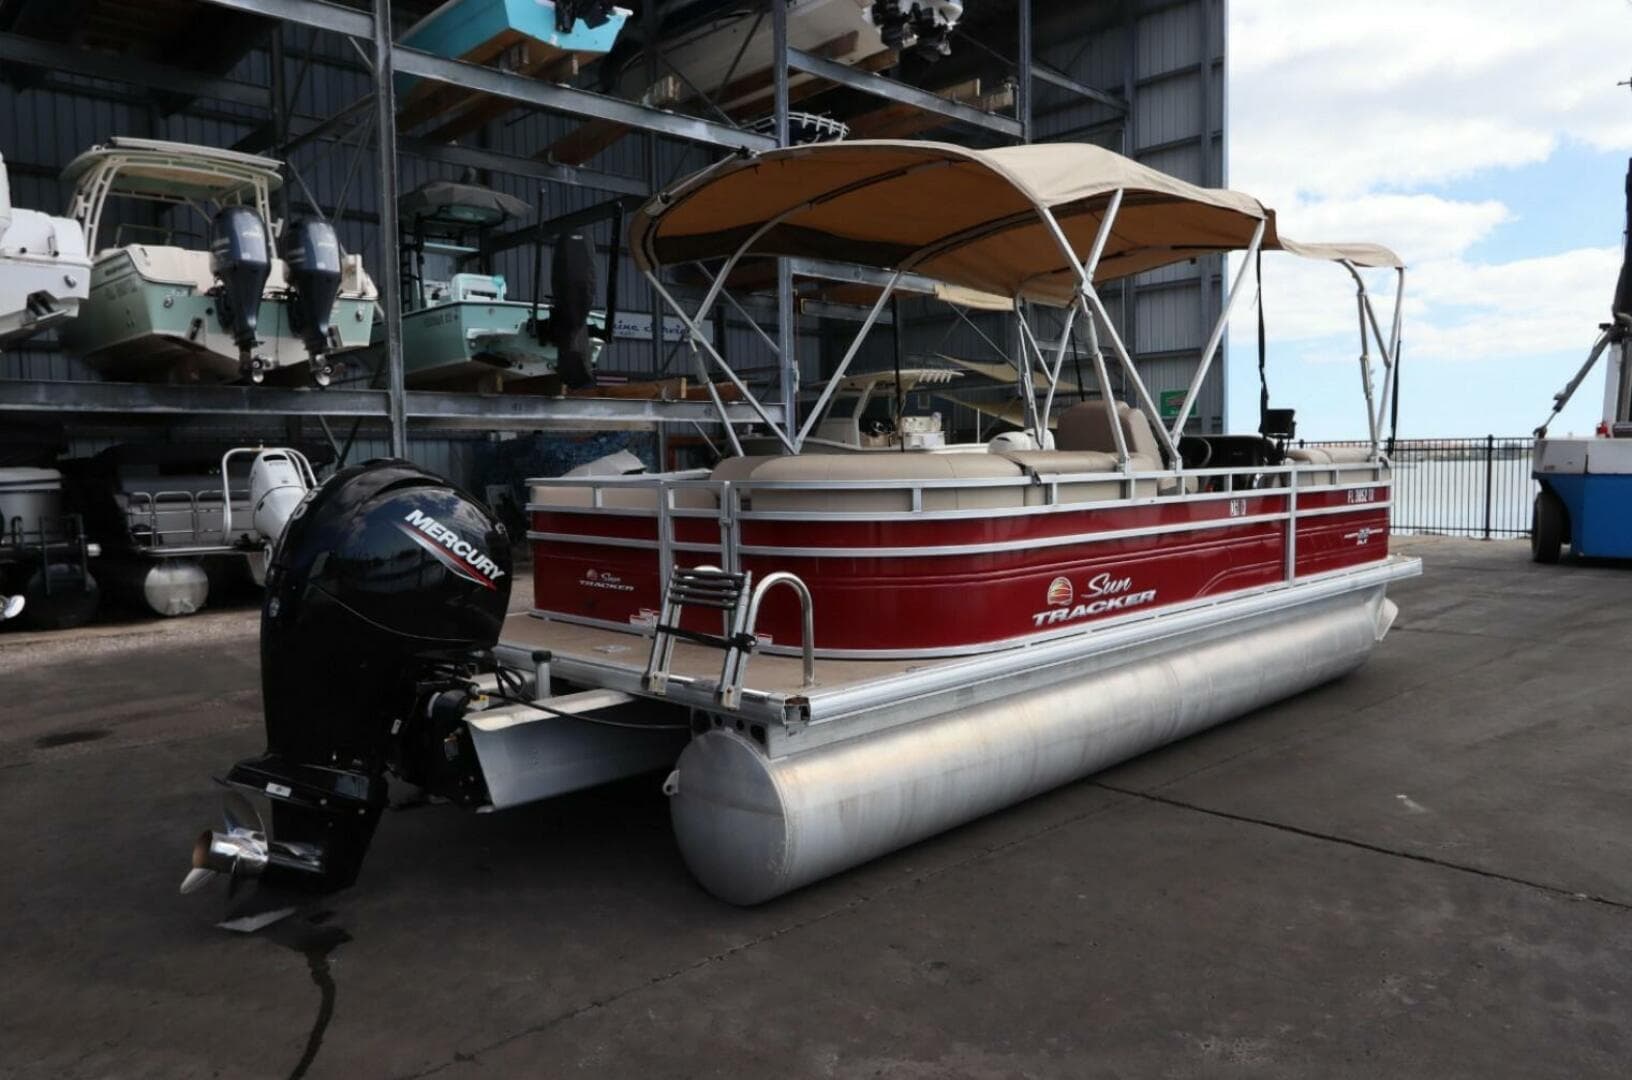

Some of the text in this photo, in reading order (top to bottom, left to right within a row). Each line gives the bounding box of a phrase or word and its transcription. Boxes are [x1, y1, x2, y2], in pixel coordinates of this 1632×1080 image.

[404, 508, 505, 580] MERCURY
[1080, 572, 1132, 599] Sun
[1032, 589, 1157, 626] TRACKER
